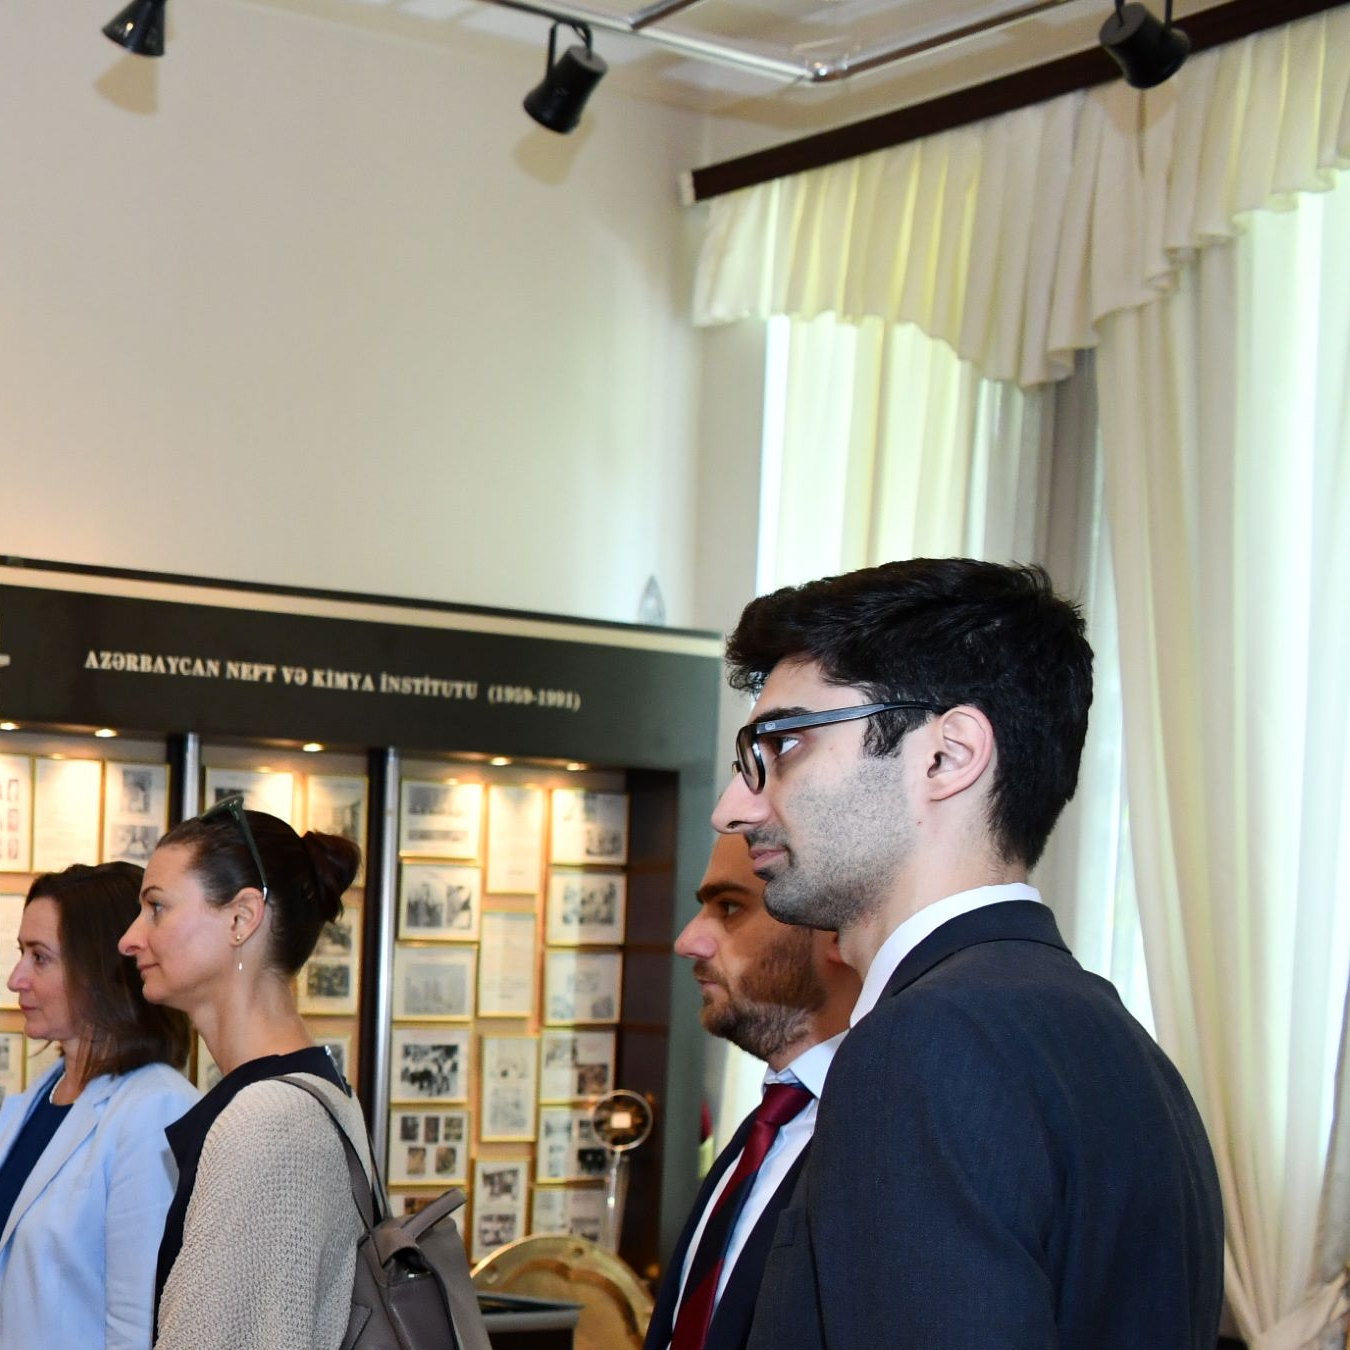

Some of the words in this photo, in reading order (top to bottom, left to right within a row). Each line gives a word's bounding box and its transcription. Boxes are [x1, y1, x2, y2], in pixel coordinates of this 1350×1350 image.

[84, 650, 221, 678] AZƏRBAYCAN
[225, 660, 278, 683] NEFT
[280, 666, 309, 686] VƏ
[311, 669, 375, 692] KİMYA
[379, 672, 479, 699] İNSTİTUTU
